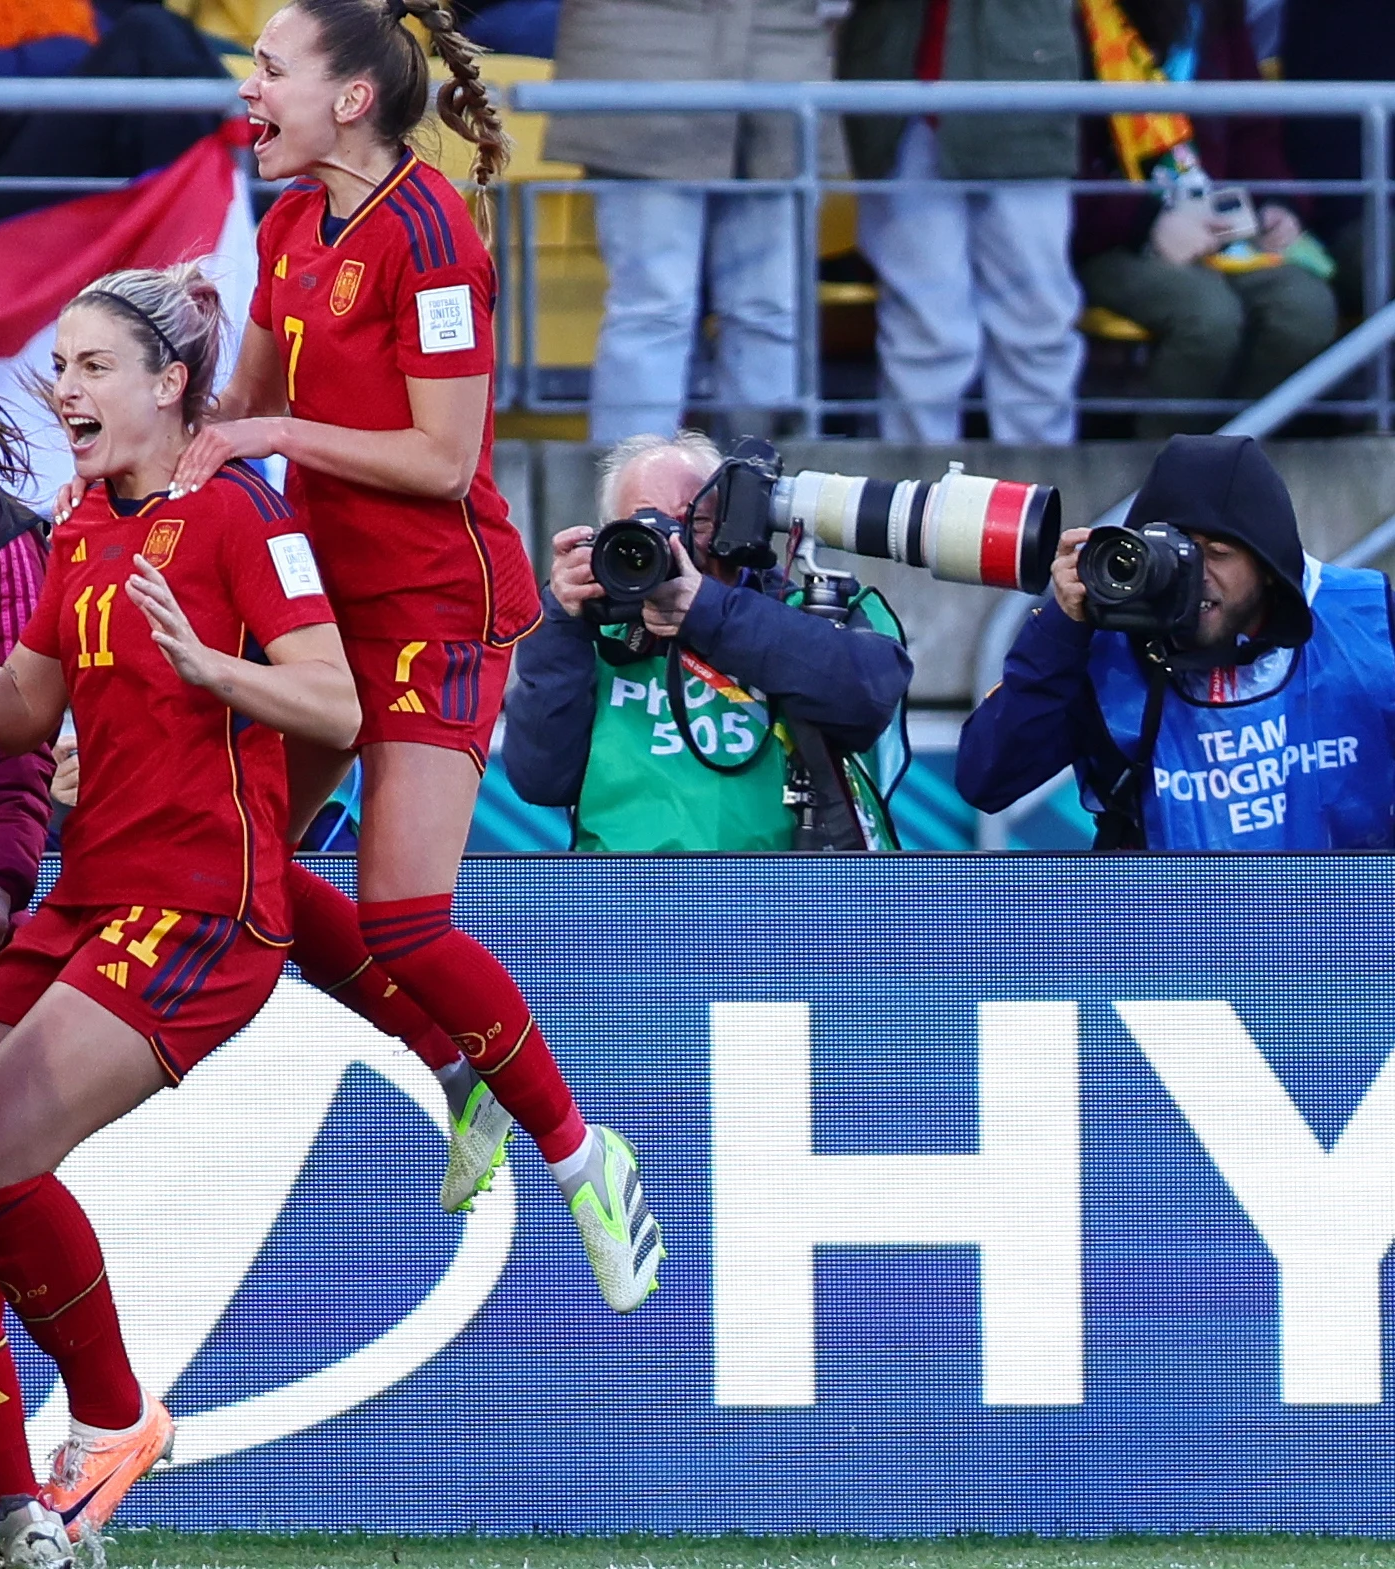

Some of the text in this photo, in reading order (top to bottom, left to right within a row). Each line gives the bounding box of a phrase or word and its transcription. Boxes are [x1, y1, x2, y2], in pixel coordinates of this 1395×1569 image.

[429, 297, 460, 308] FOOTBALL
[430, 306, 460, 320] UNITES
[284, 315, 305, 402] 7
[74, 584, 118, 669] 11
[394, 641, 428, 682] 7
[610, 675, 767, 715] PhO
[650, 711, 755, 755] 505
[1198, 714, 1287, 764] TEAM
[1227, 792, 1287, 835] ESP
[98, 906, 183, 968] 11
[709, 1000, 1395, 1406] HY
